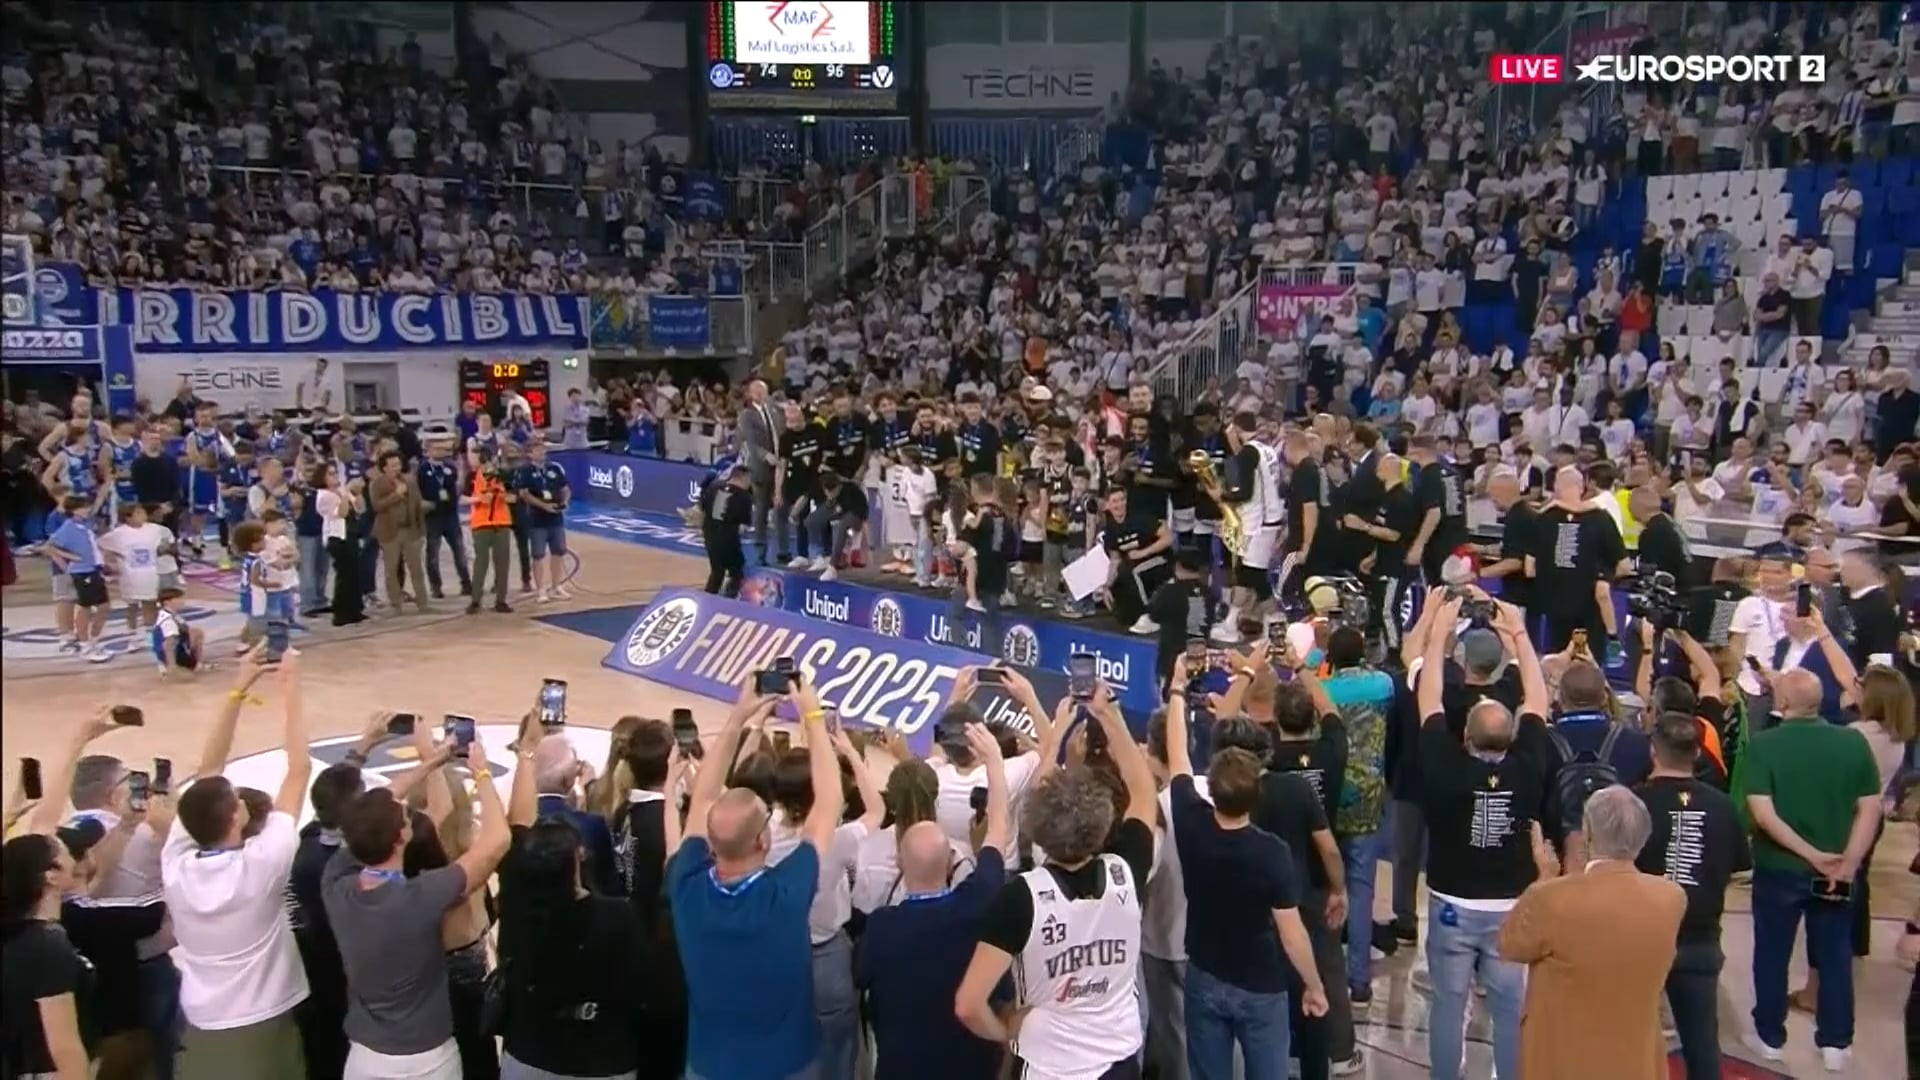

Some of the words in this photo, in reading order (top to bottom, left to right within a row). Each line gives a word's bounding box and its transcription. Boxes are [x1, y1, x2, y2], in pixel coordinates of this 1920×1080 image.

[784, 10, 819, 25] MAF
[749, 40, 772, 53] Maf
[774, 40, 828, 55] Logistics
[760, 64, 777, 78] 74
[826, 65, 844, 78] 96
[962, 68, 1094, 99] TECHNE
[176, 368, 282, 390] TECHNE
[494, 364, 519, 378] 0:0
[805, 588, 849, 622] Unipol
[930, 613, 981, 648] Unol
[817, 646, 958, 734] 2025
[1041, 923, 1067, 946] 33
[1044, 939, 1127, 979] VIRTUS
